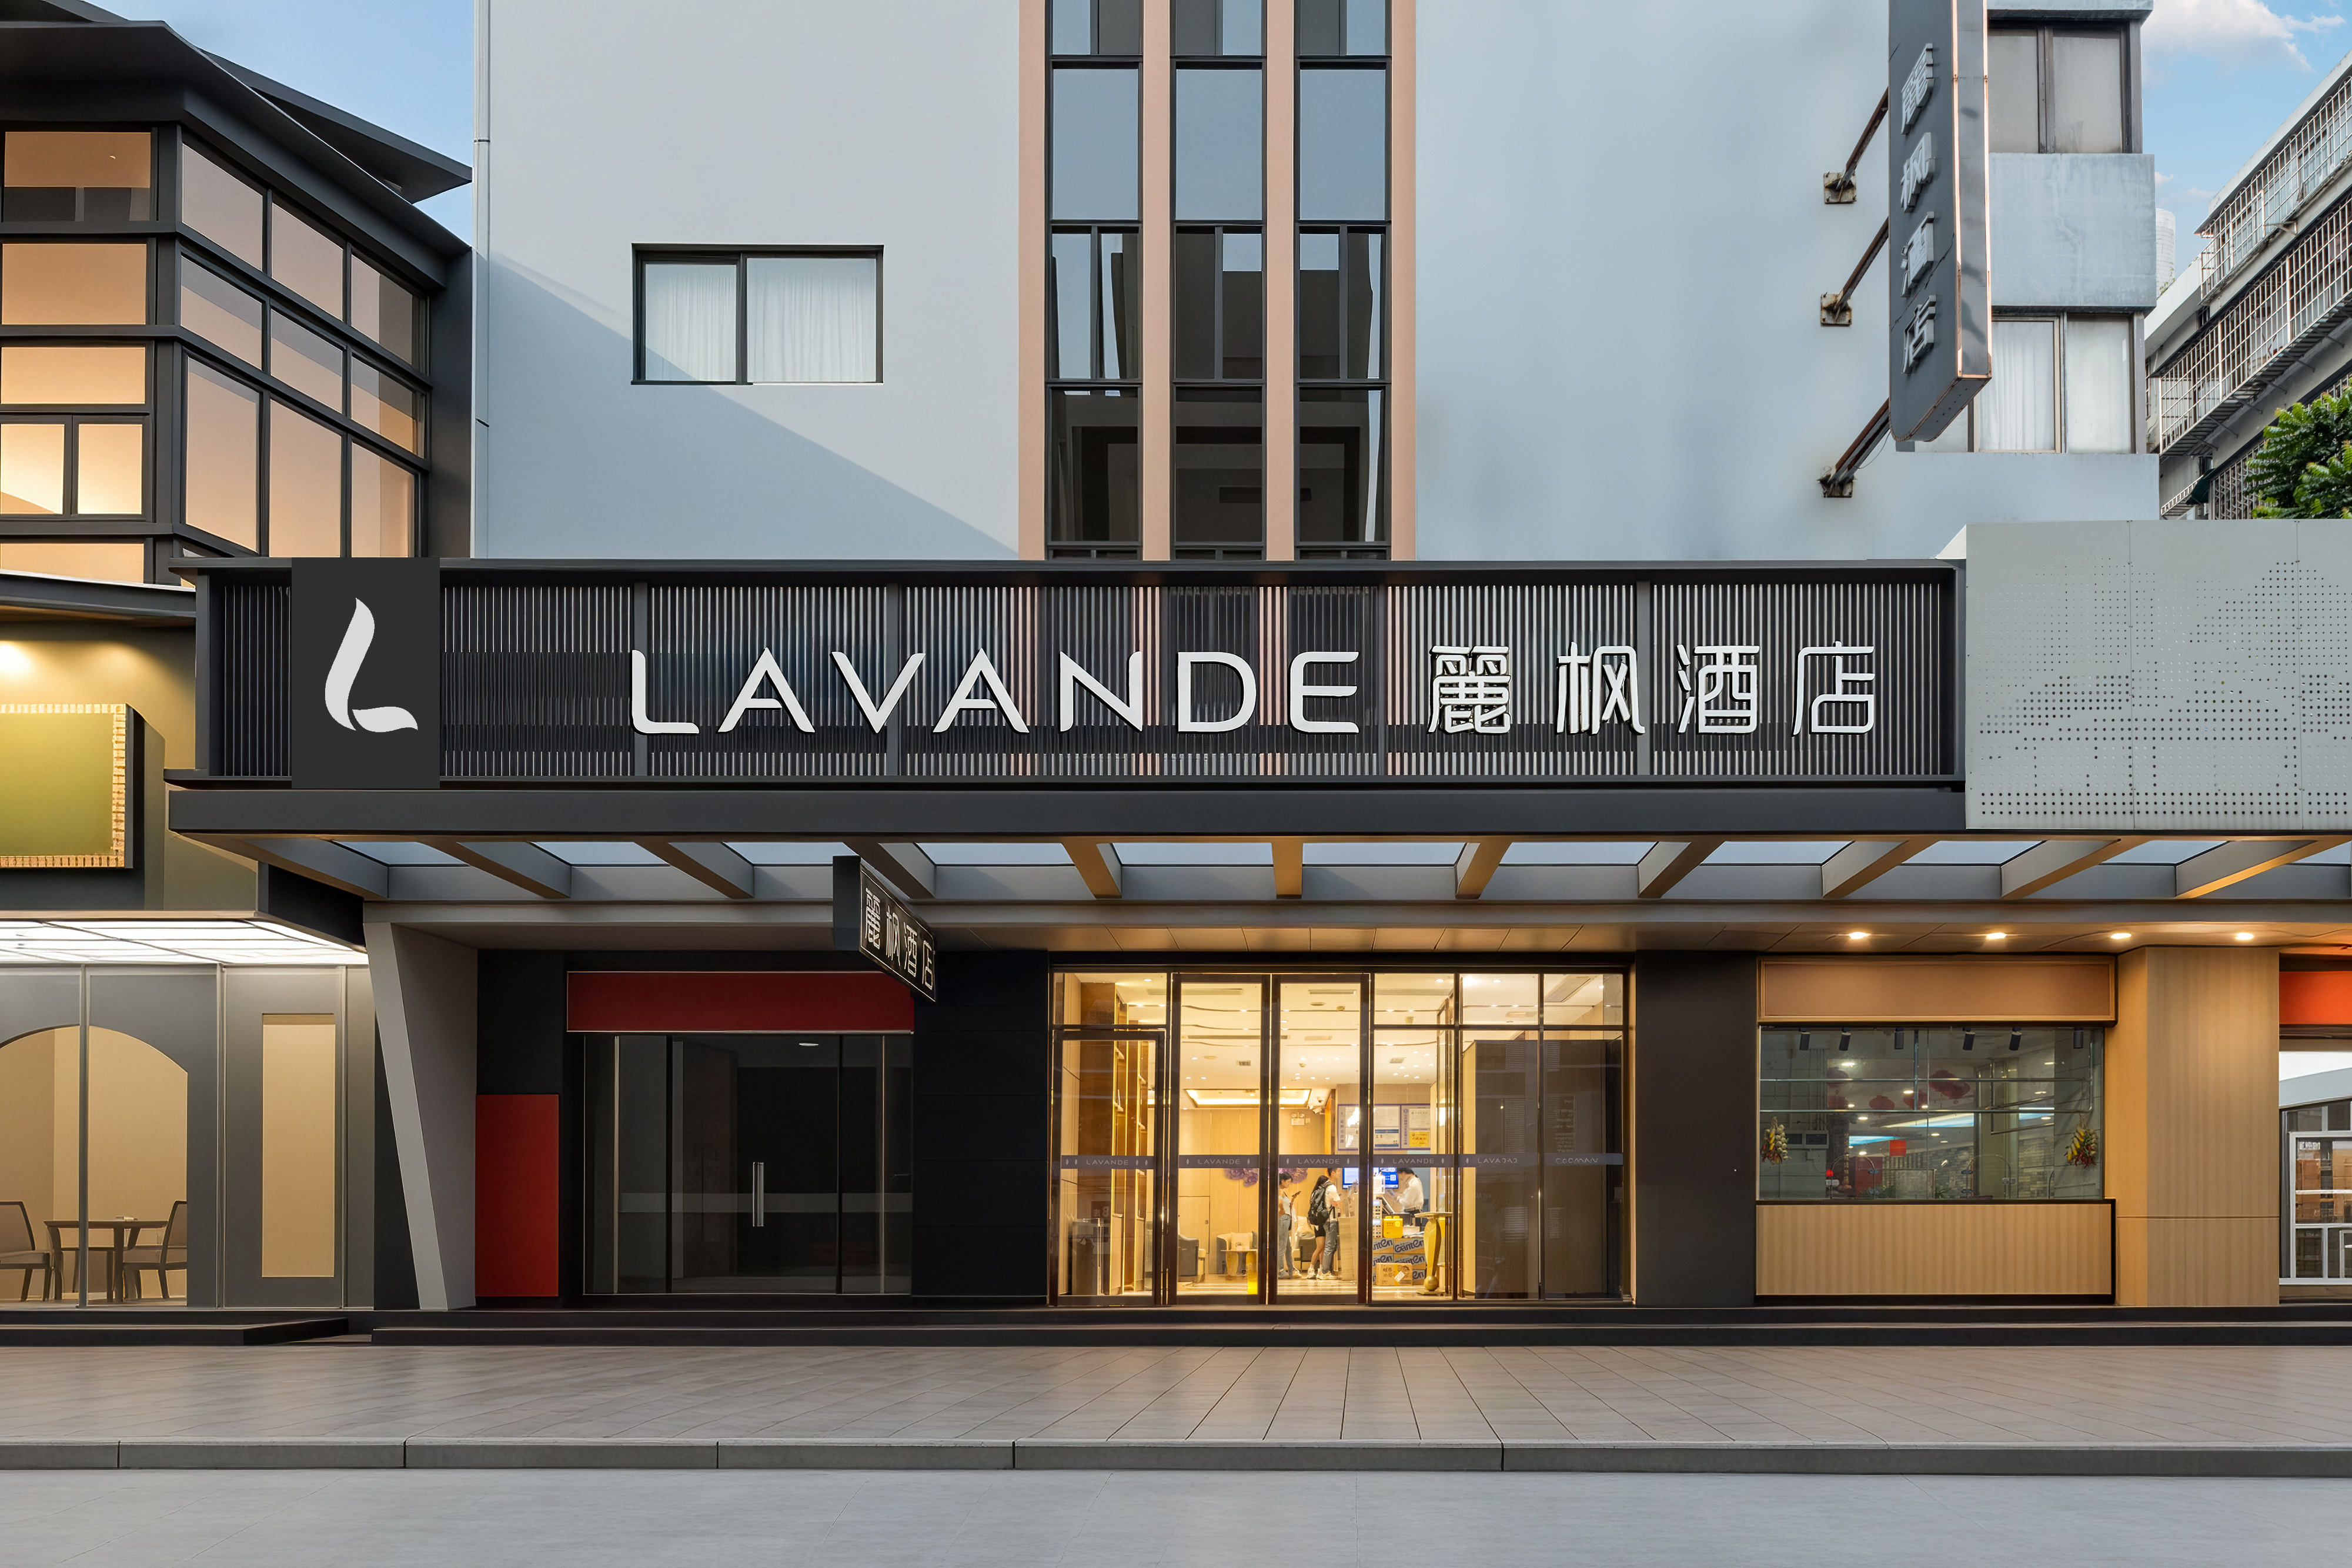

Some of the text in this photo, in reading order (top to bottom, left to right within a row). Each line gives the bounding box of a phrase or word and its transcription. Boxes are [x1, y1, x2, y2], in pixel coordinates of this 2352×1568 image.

[1900, 43, 1936, 375] 麗枫酒店
[631, 640, 1876, 737] LAVANDE 麗枫酒店
[865, 887, 935, 991] 麗枫酒店
[1395, 1239, 1424, 1253] Ganten
